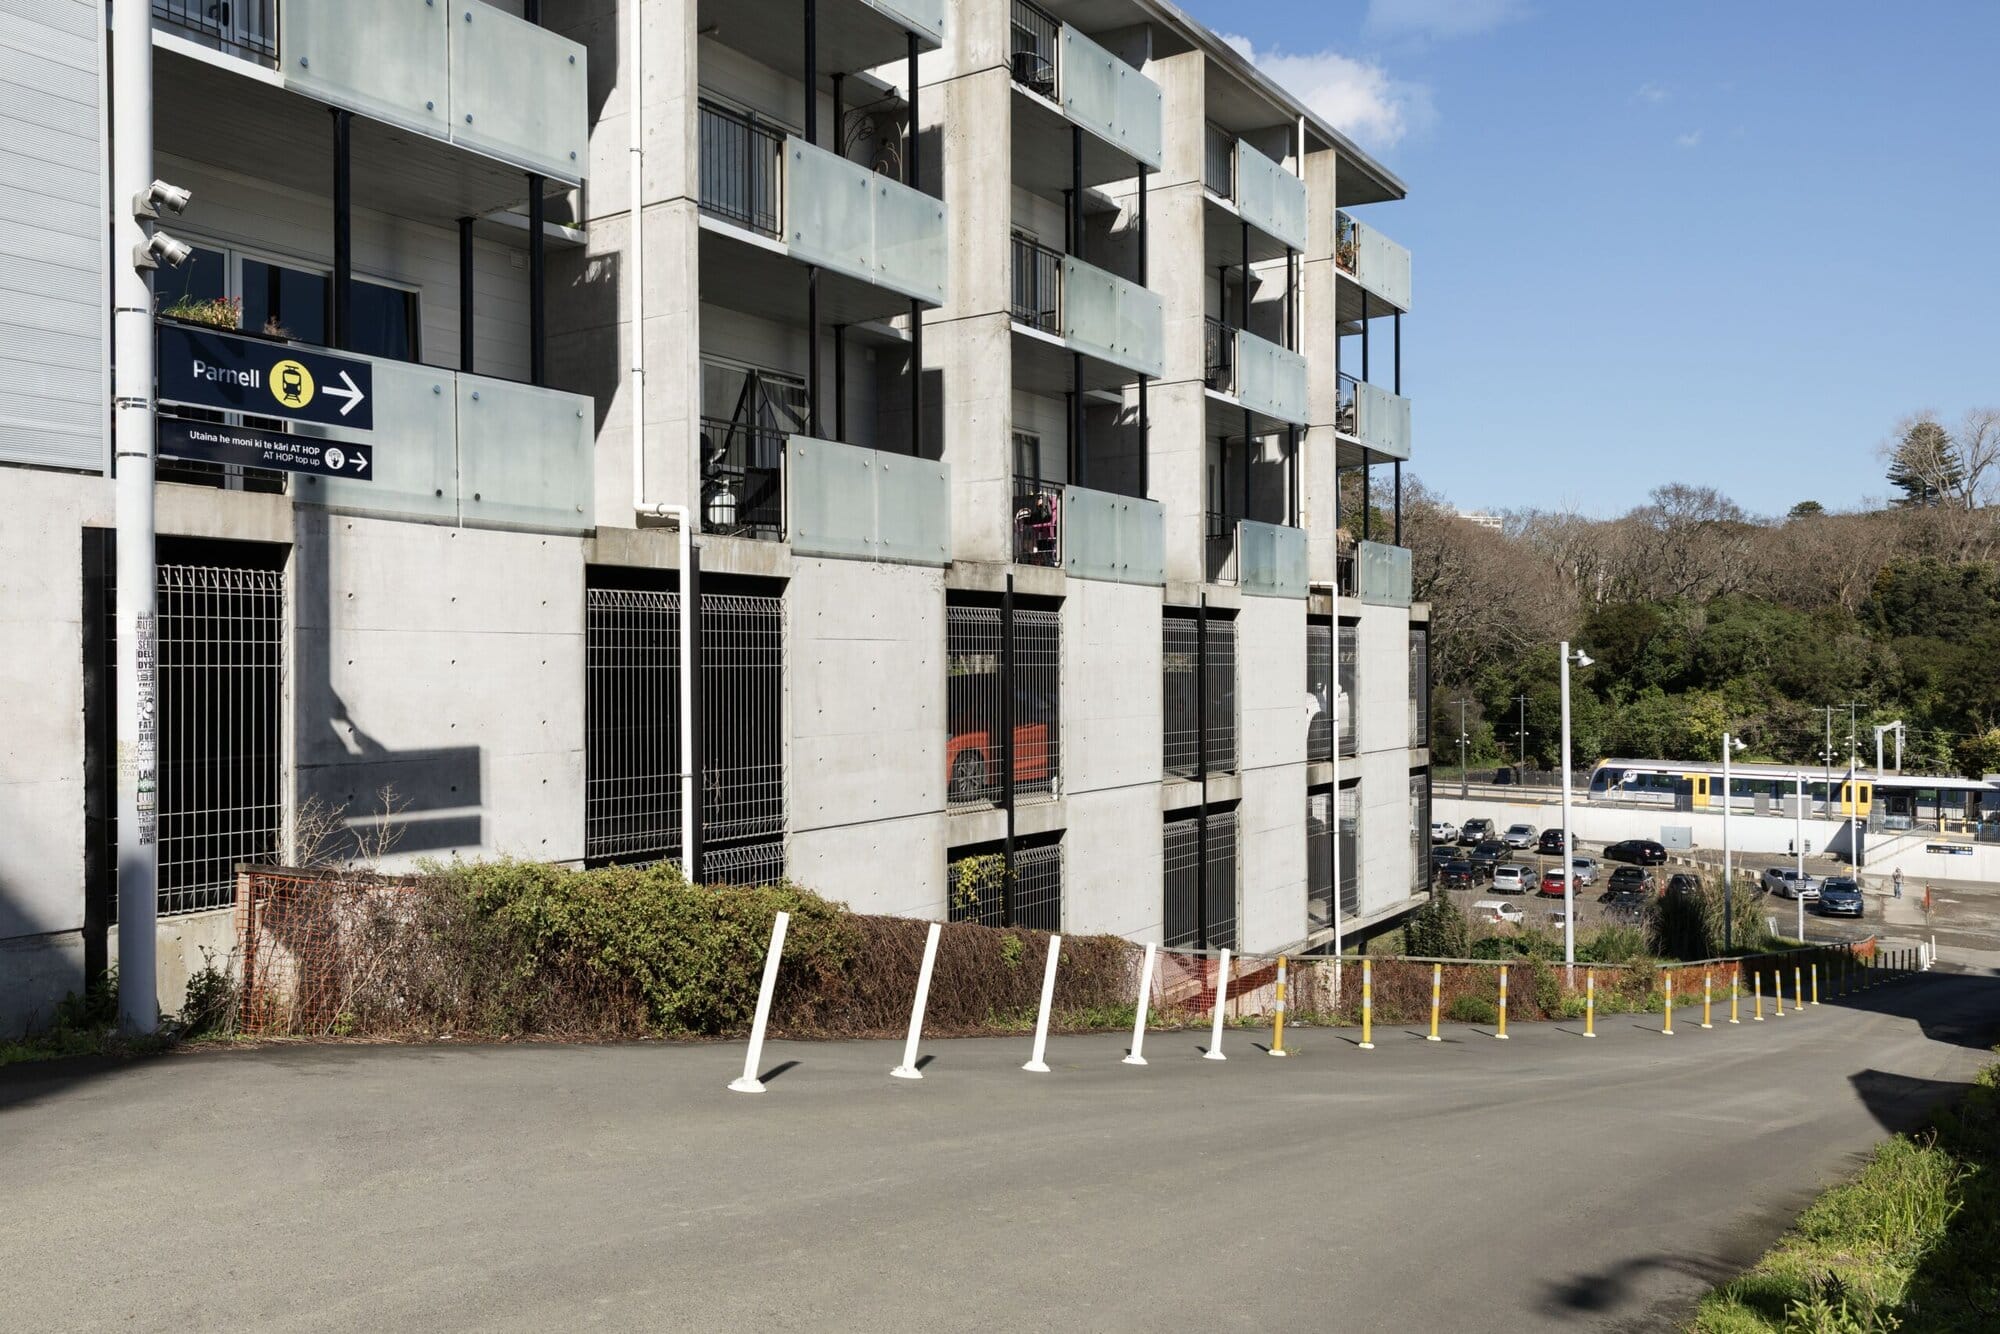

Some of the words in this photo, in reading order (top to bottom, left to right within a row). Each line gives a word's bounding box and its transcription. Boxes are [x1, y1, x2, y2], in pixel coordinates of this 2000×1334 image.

[193, 359, 260, 389] Parnell
[190, 430, 217, 442] Utaina
[219, 434, 231, 444] he
[232, 437, 253, 447] moni
[254, 439, 262, 448] ki
[263, 441, 272, 450] te
[290, 444, 301, 453] AT
[302, 445, 320, 455] HOP
[263, 451, 274, 460] AT
[276, 452, 294, 461] HOP
[295, 455, 308, 465] top
[310, 458, 320, 466] up
